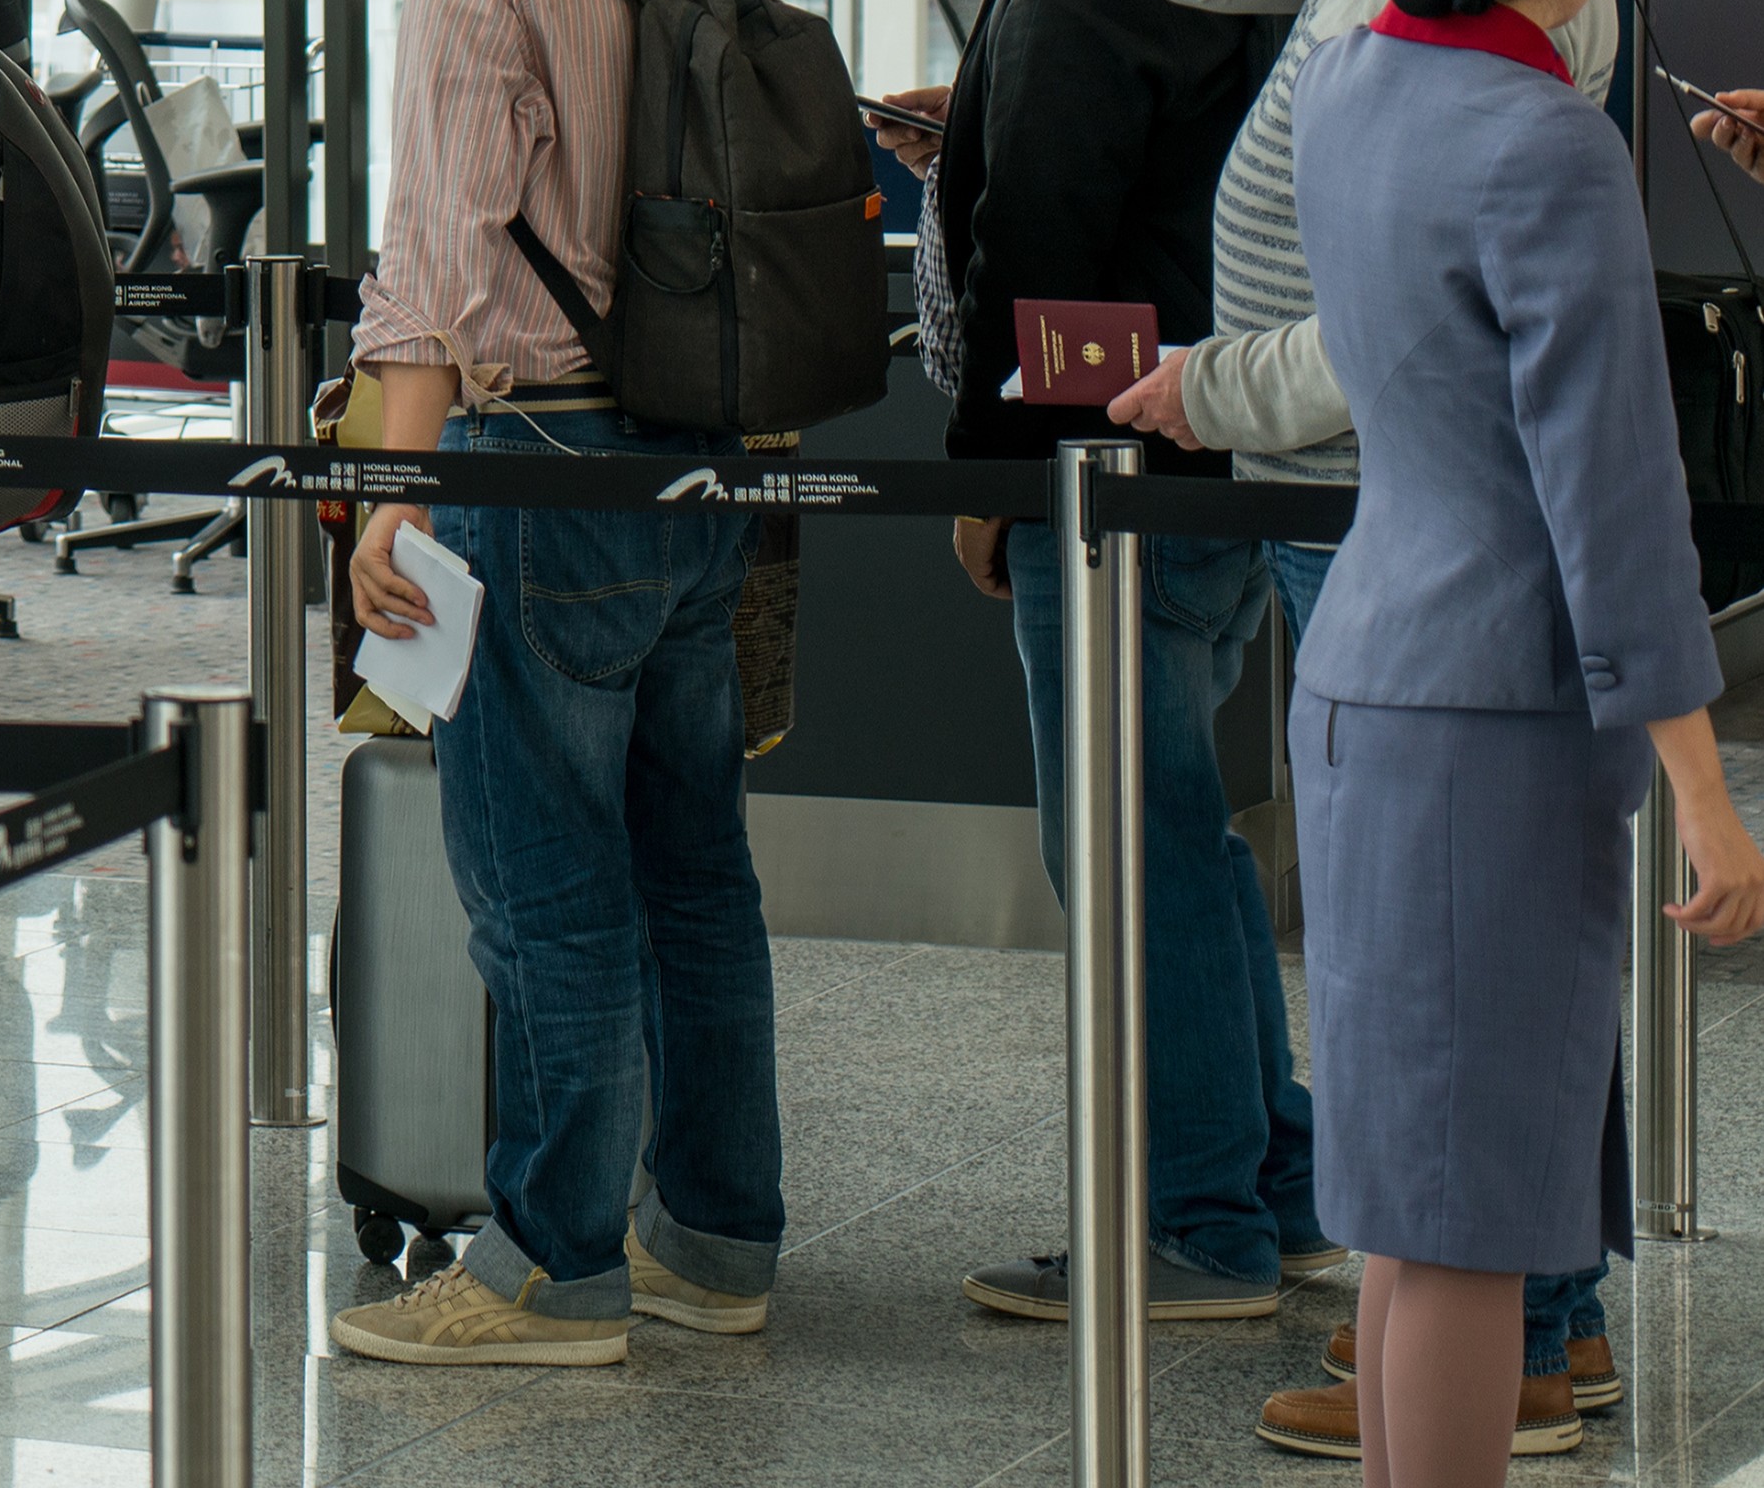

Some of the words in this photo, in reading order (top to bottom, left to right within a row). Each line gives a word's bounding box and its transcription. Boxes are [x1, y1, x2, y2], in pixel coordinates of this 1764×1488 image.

[128, 292, 187, 300] INTERNATIONAL
[330, 462, 356, 477] 香港
[363, 463, 391, 472] HONG
[393, 464, 421, 474] KONG
[302, 475, 356, 491] 國際機場
[363, 473, 440, 485] INTERNATIONAL
[763, 473, 790, 488] 香港
[798, 474, 827, 483] HONG
[829, 474, 858, 483] KONG
[363, 484, 405, 494] AIRPORT
[798, 484, 879, 494] INTERNATIONAL
[734, 487, 790, 503] 國際機場
[798, 495, 842, 504] AIRPORT
